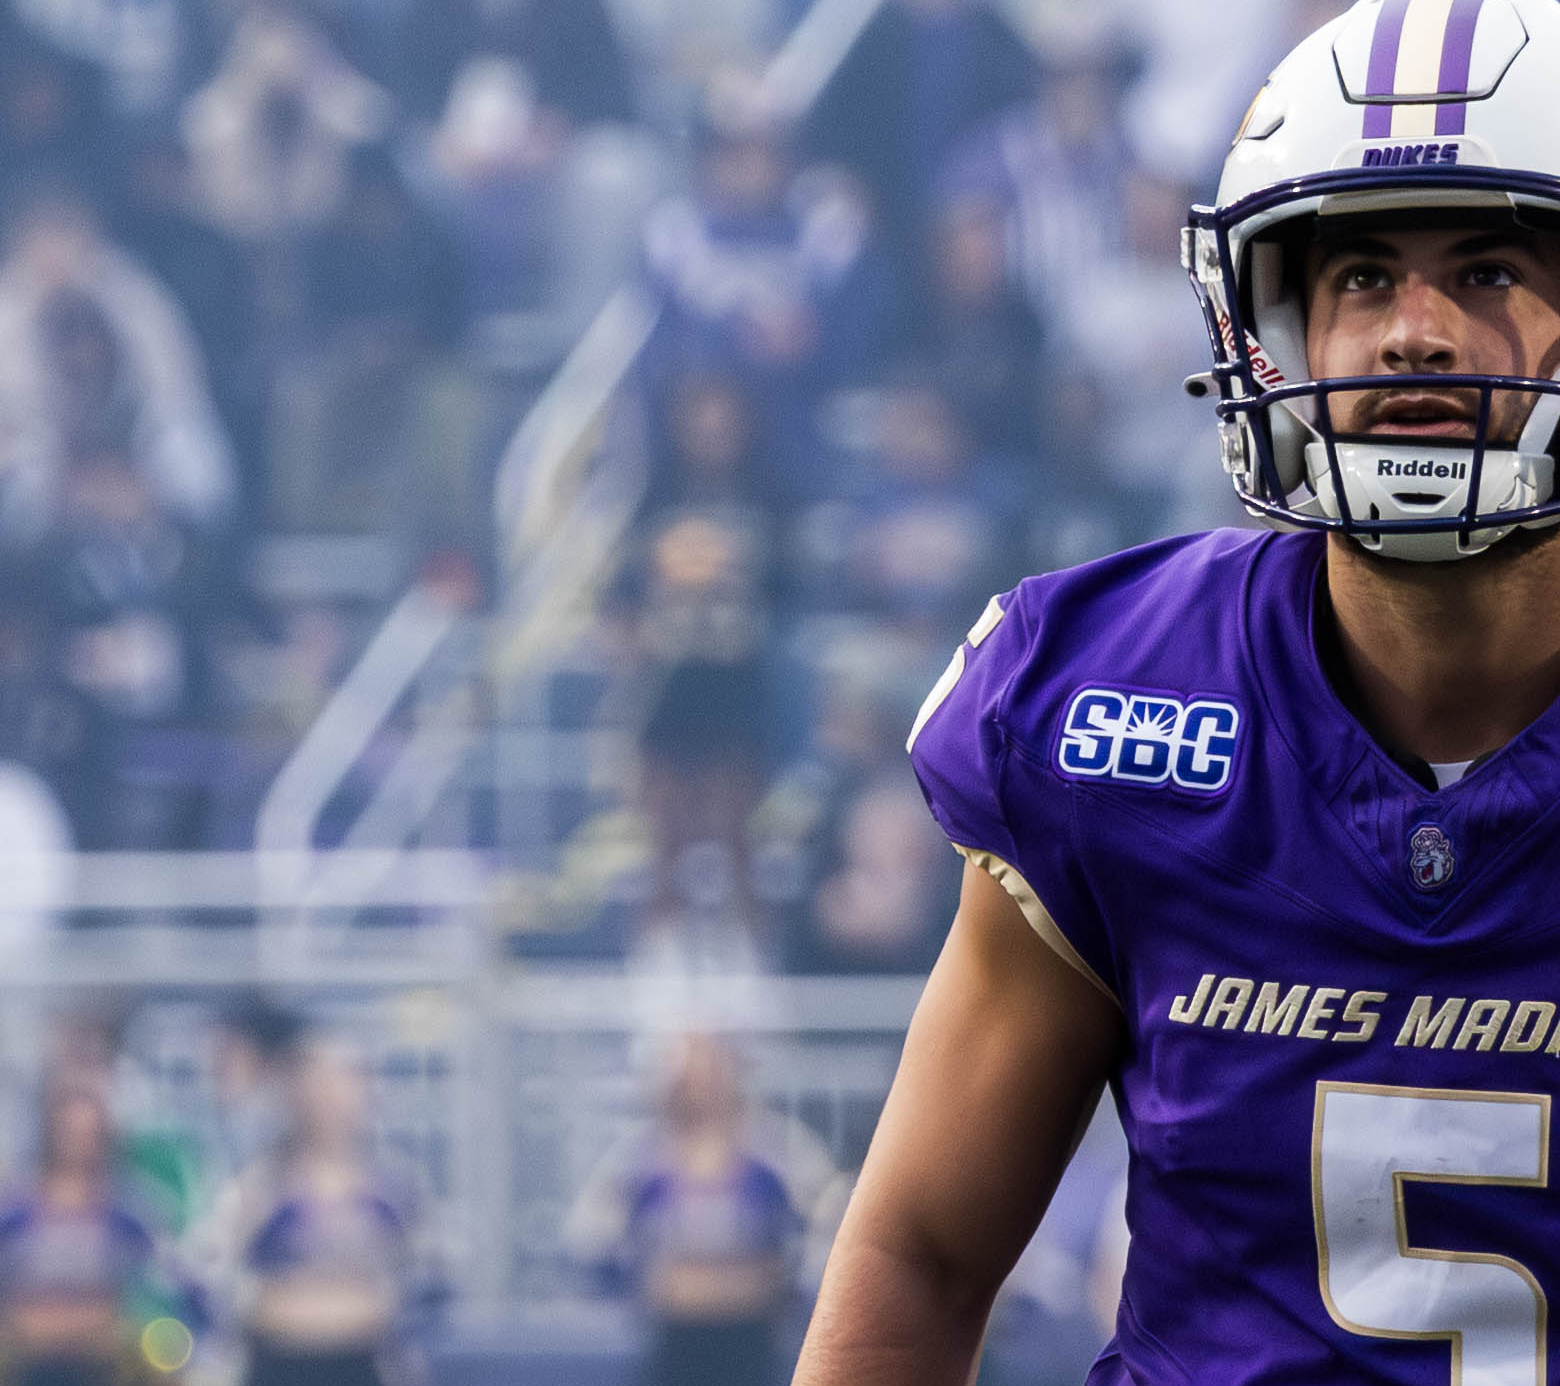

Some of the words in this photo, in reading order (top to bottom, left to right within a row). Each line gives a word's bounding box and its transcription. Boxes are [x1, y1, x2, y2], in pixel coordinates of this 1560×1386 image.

[1362, 143, 1459, 166] DUKES
[1377, 459, 1466, 479] Riddell
[1058, 688, 1239, 791] SBC
[1168, 974, 1388, 1042] JAMES
